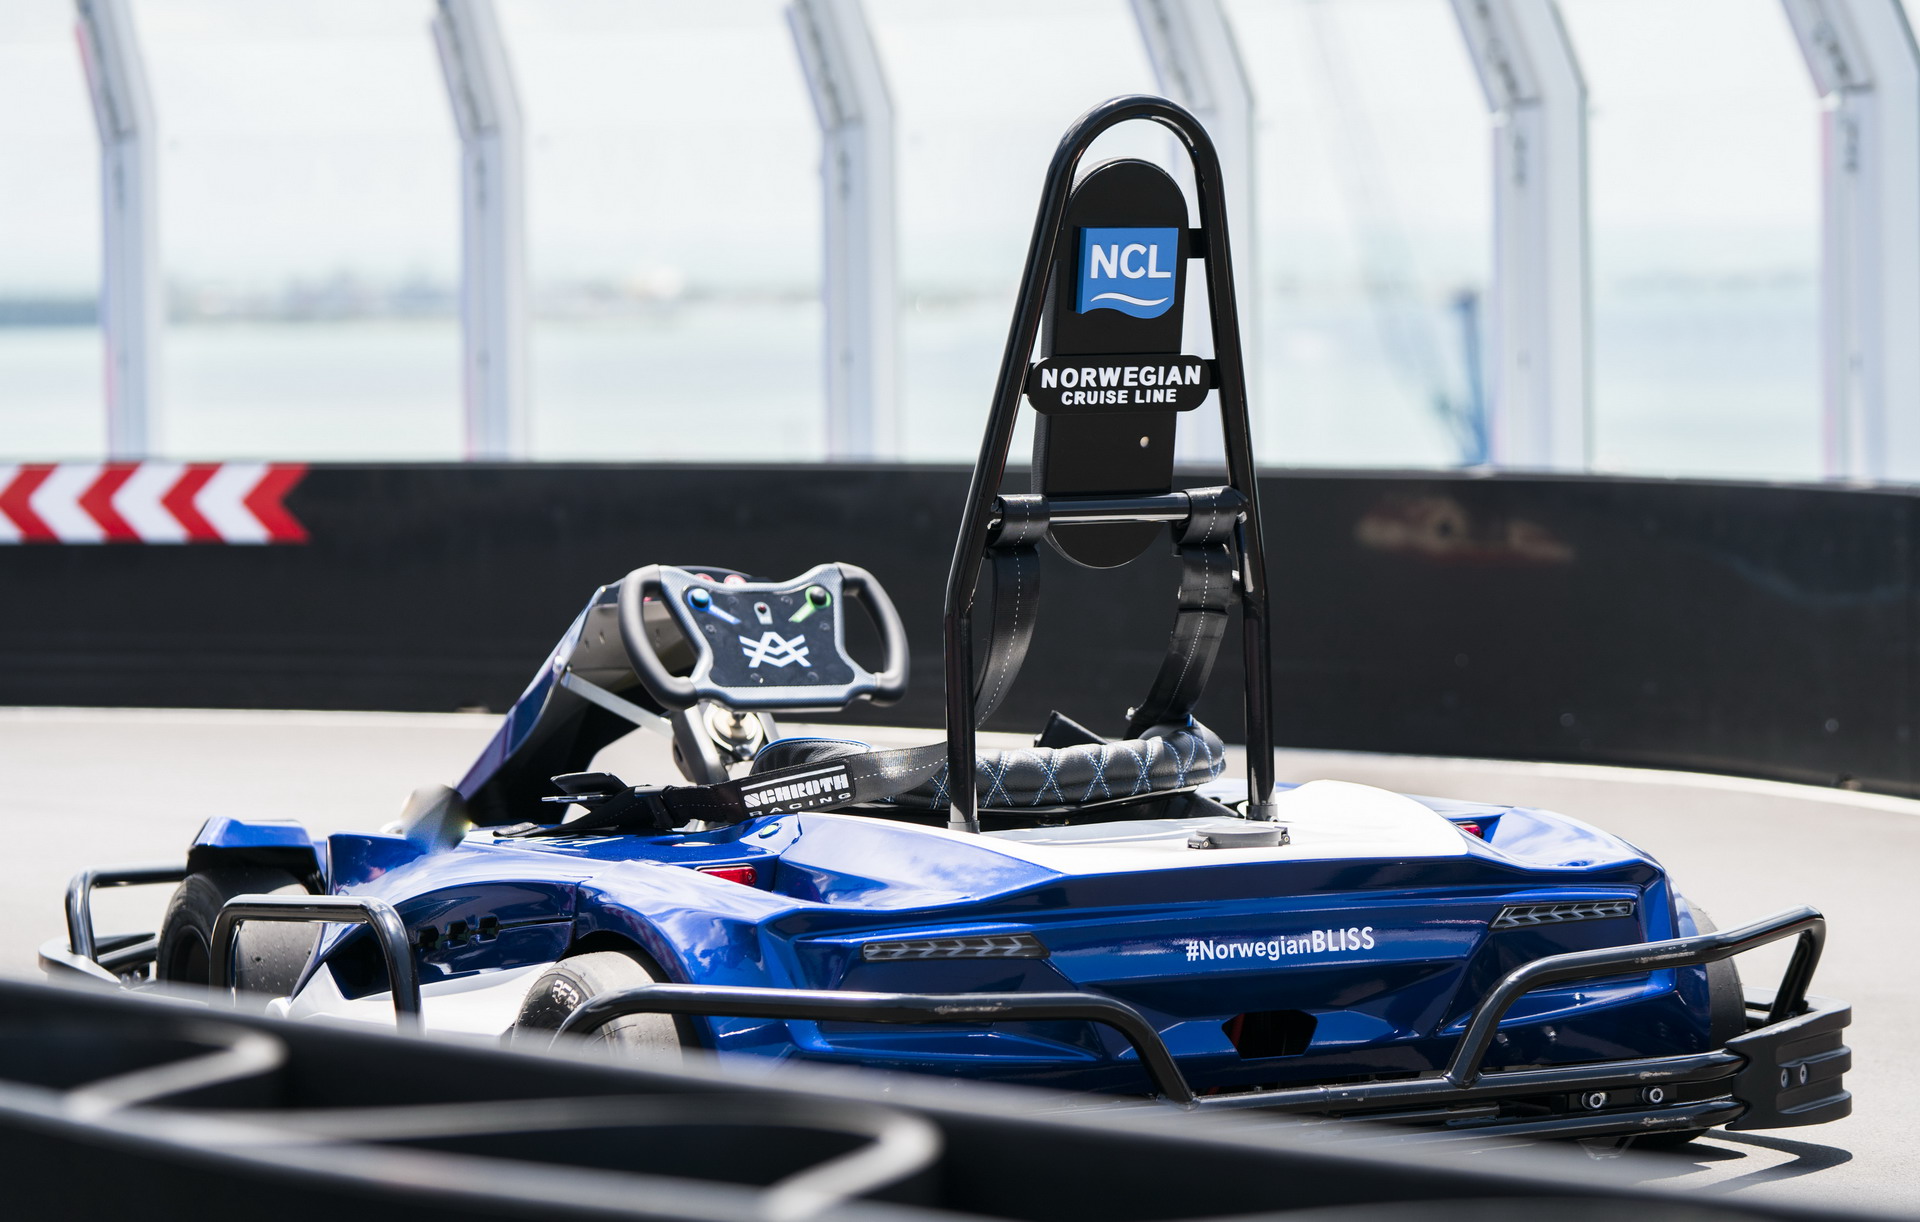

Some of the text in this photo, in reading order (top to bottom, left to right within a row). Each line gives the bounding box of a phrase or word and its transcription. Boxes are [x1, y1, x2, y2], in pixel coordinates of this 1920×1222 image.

[1090, 244, 1171, 279] NCL
[1041, 365, 1201, 389] NORWEGIAN
[1061, 389, 1177, 405] CRUISE LINE
[743, 773, 849, 808] SCHROTH
[749, 792, 851, 817] RACING
[1186, 926, 1375, 961] #NorwegianBLISS
